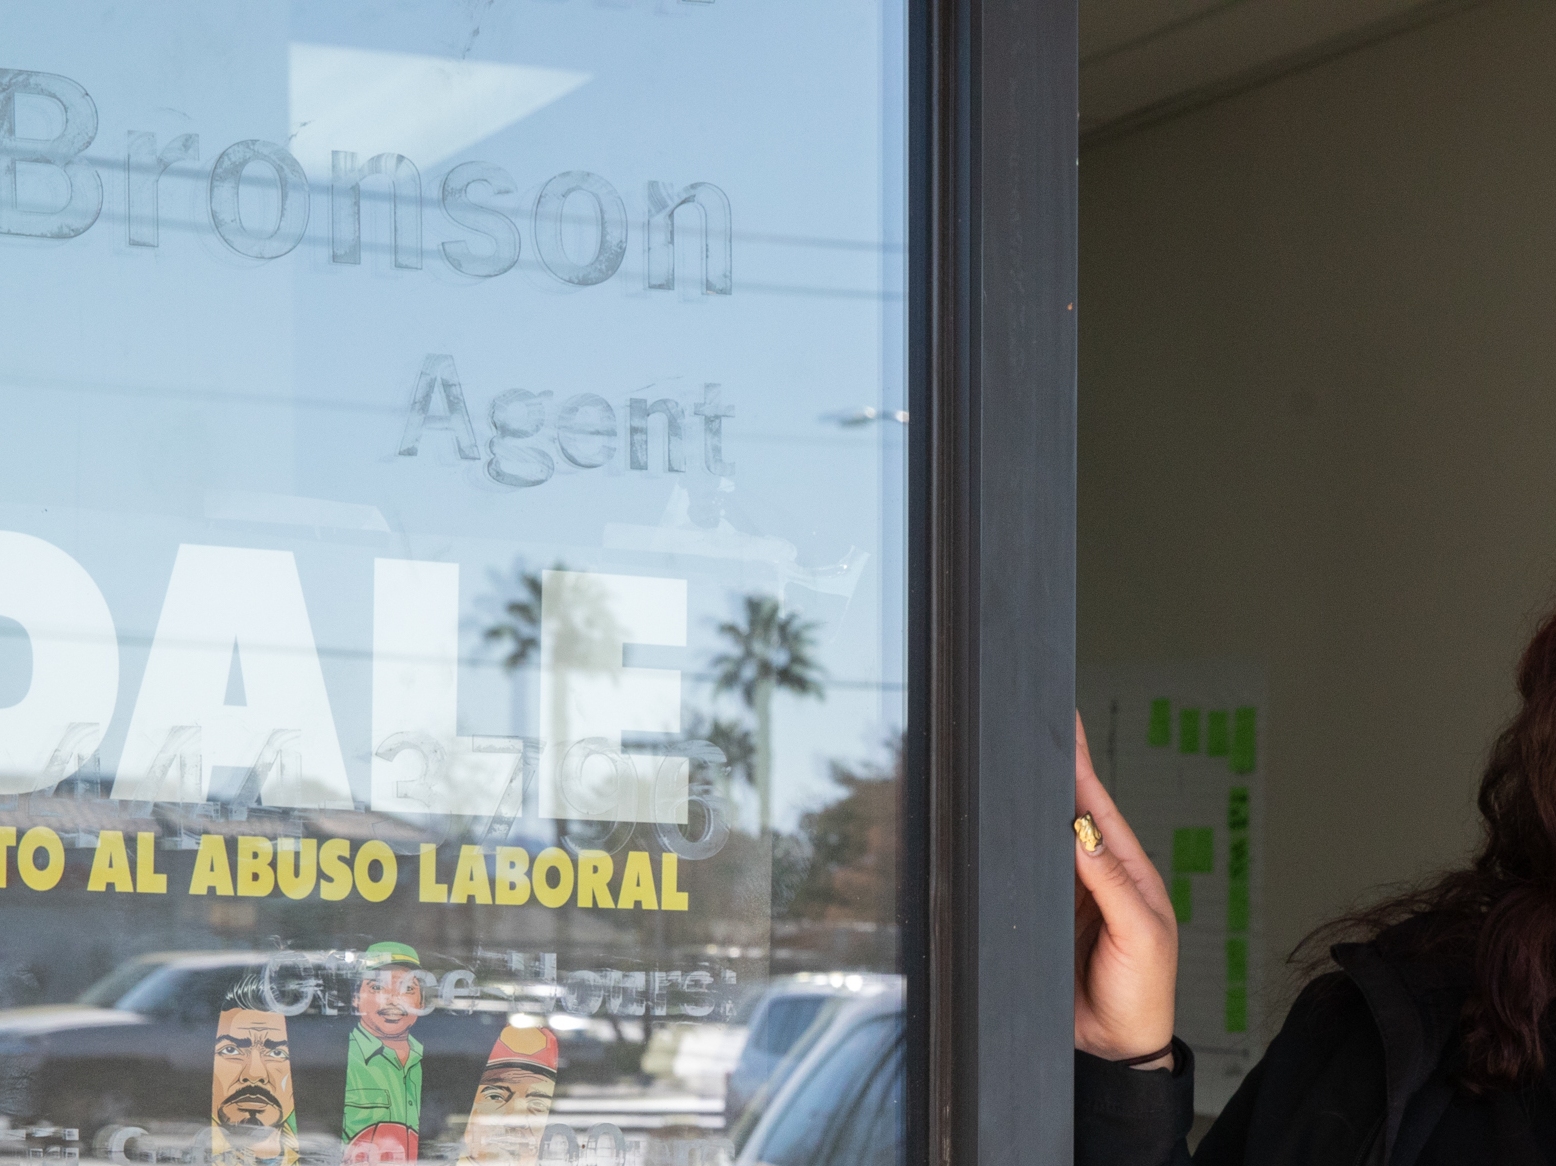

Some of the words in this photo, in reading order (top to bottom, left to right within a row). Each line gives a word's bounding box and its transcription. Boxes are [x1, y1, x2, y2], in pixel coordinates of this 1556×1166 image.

[0, 66, 734, 297] Bronson
[396, 352, 738, 488] Agent
[86, 829, 168, 894] AL
[188, 834, 399, 903] ABUSO
[418, 843, 690, 911] LABORAL
